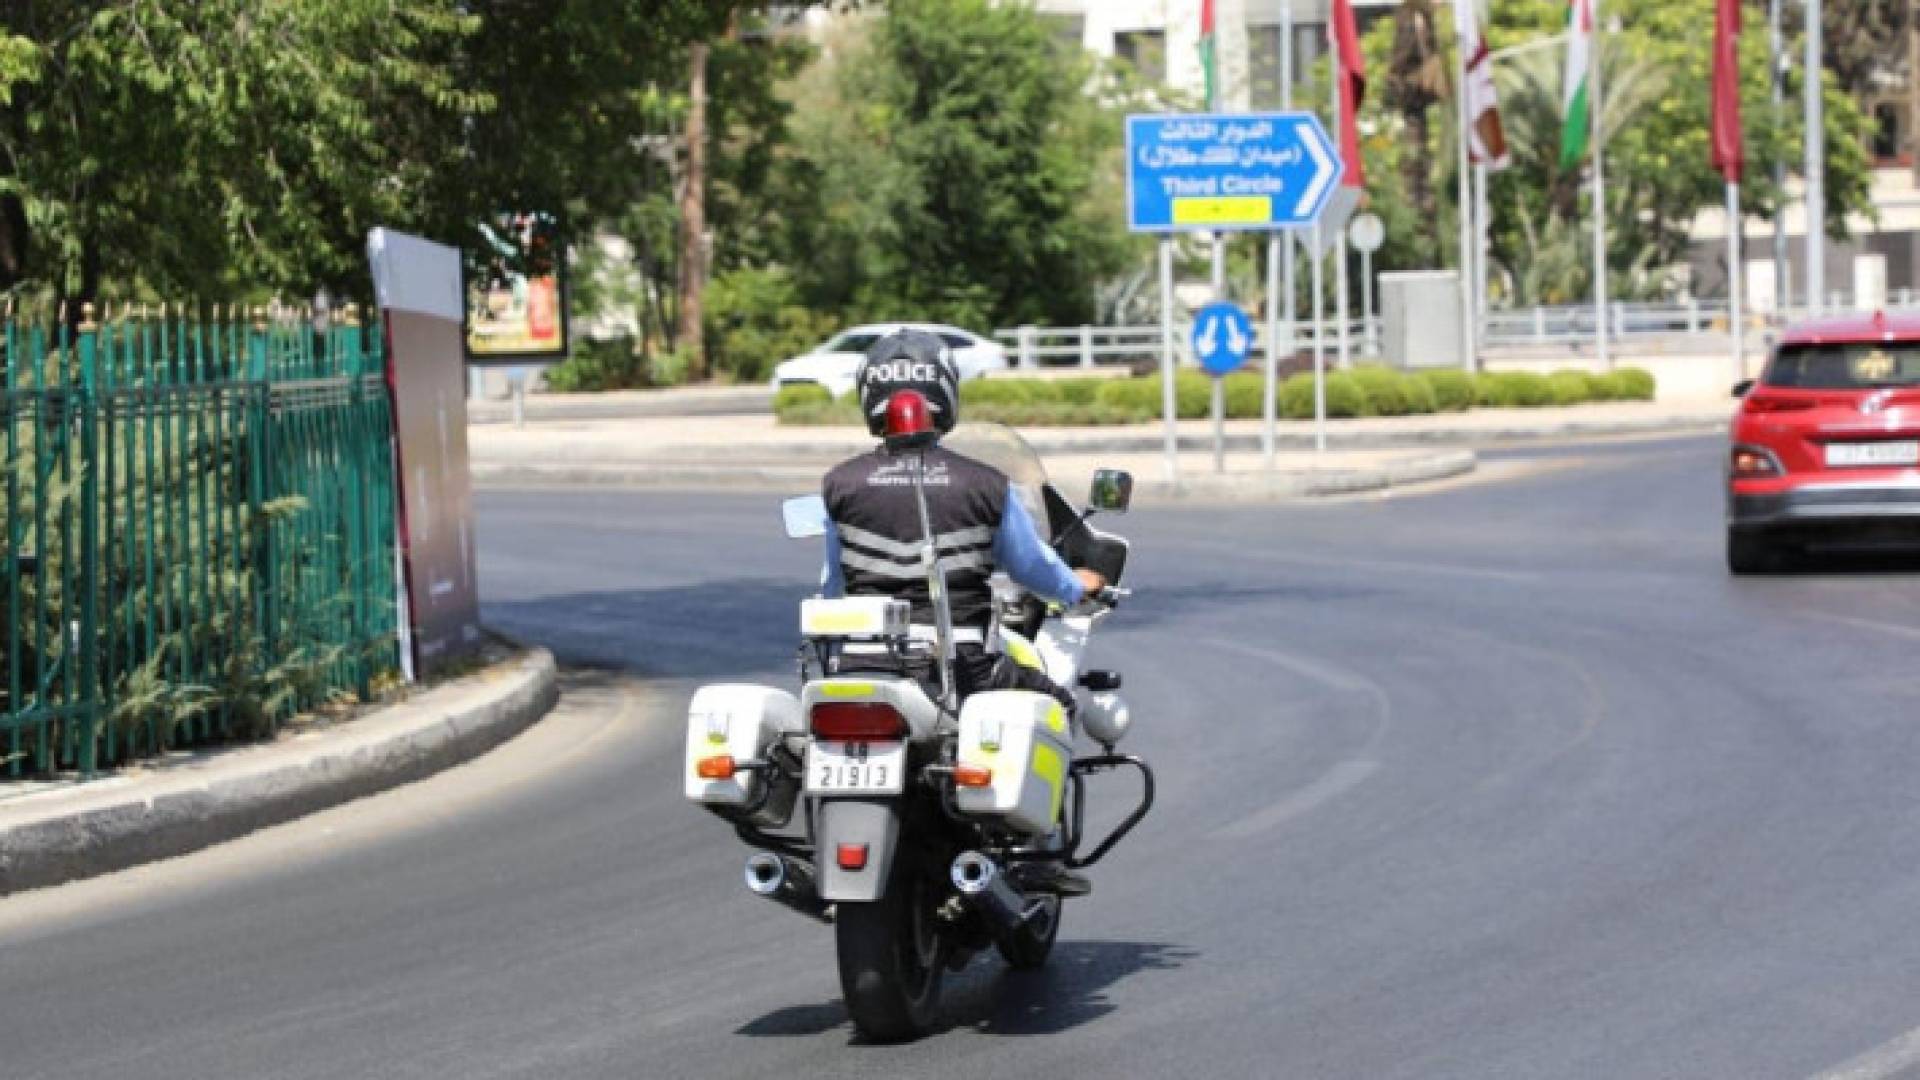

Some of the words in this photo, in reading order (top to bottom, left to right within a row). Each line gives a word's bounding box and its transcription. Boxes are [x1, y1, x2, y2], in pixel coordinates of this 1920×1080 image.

[1160, 120, 1218, 140] الثالث
[1220, 121, 1273, 143] الدوار
[1161, 176, 1217, 194] Third
[1221, 174, 1283, 193] Circle
[867, 359, 936, 382] POLICE
[820, 766, 888, 786] 21913
